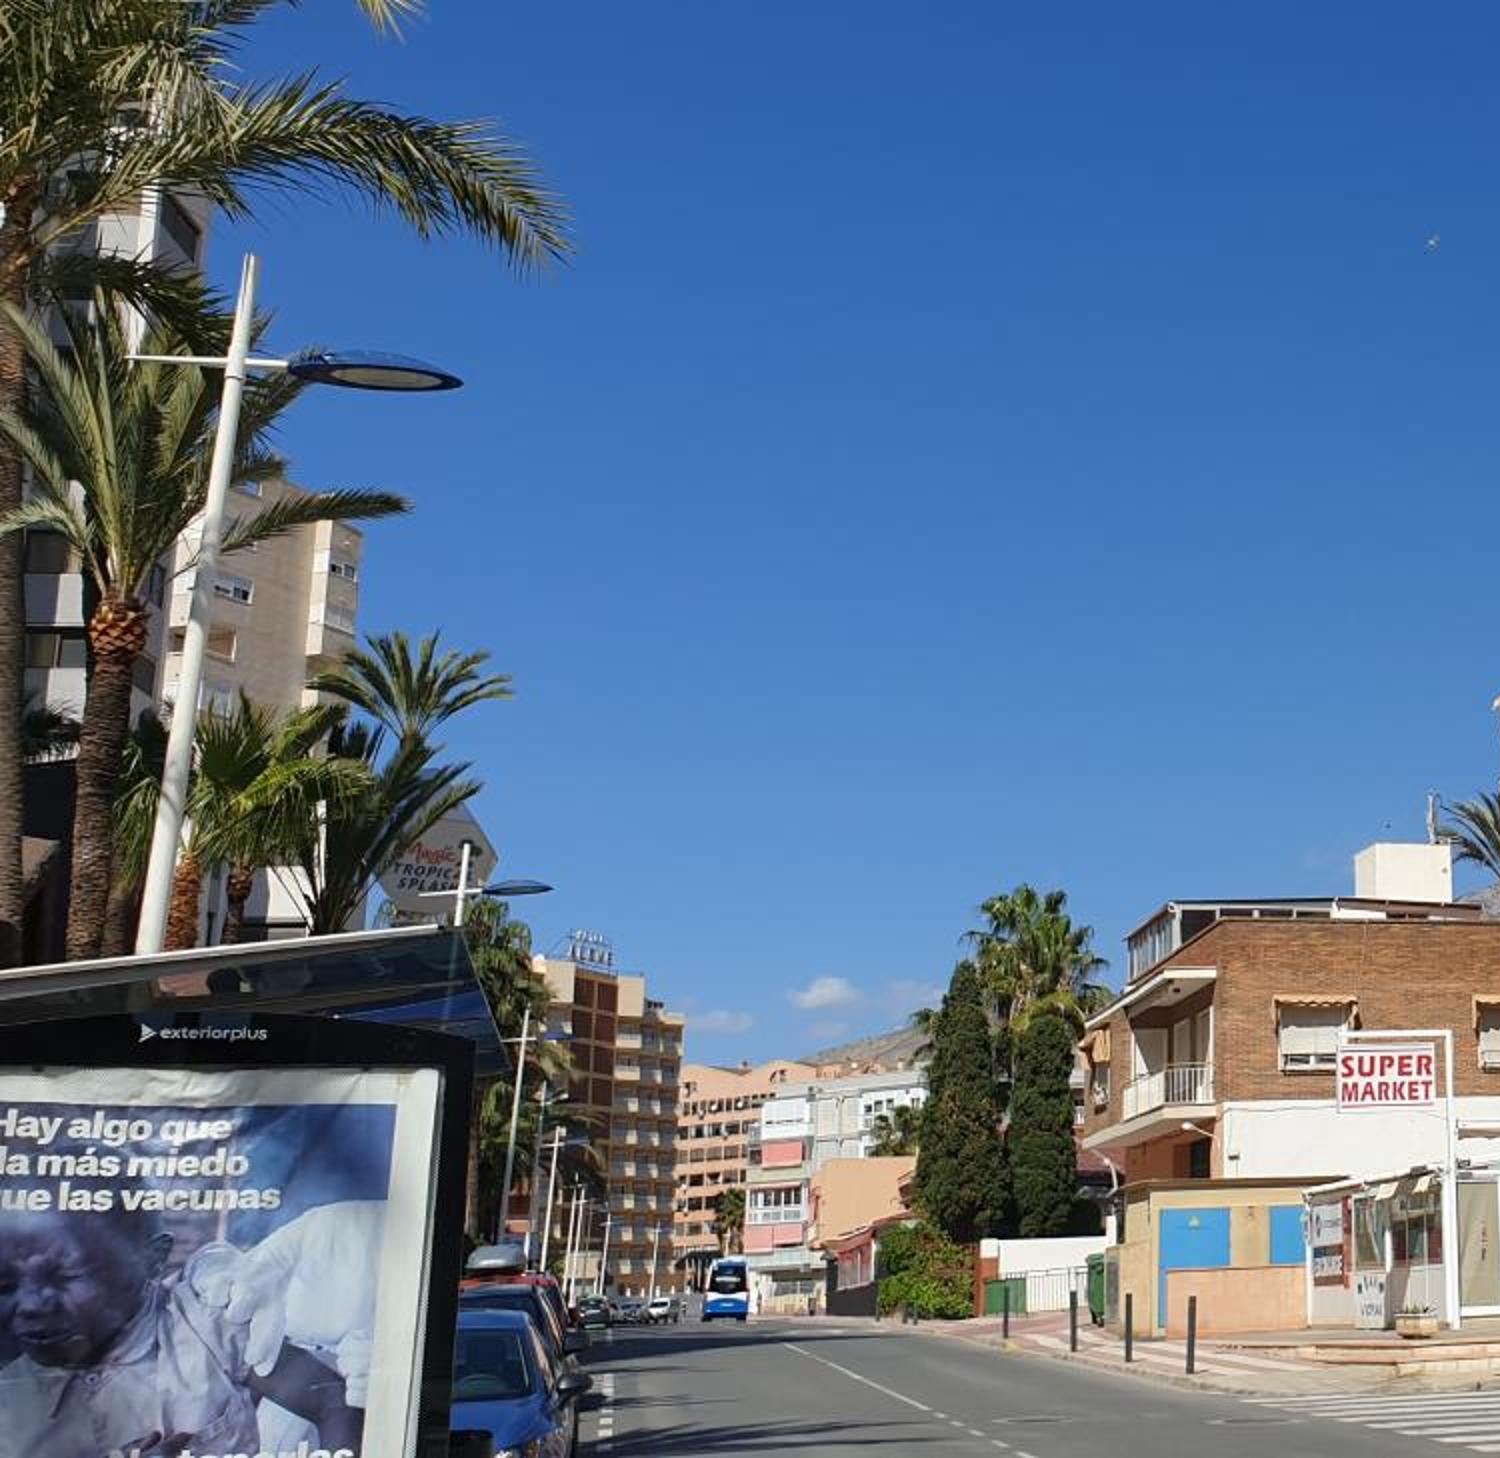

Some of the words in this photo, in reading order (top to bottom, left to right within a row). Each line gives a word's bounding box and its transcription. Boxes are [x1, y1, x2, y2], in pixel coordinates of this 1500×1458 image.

[391, 863, 475, 882] TROPIC
[160, 1025, 268, 1042] exteriorplus
[1341, 1055, 1433, 1078] SUPER
[1341, 1080, 1433, 1102] MARKET
[67, 1110, 152, 1147] algo
[159, 1118, 234, 1148] que
[0, 1146, 30, 1176] a
[36, 1147, 120, 1177] más
[126, 1148, 249, 1177] miedo
[0, 1189, 51, 1212] ue
[58, 1181, 114, 1212] las
[120, 1187, 282, 1212] vacunas
